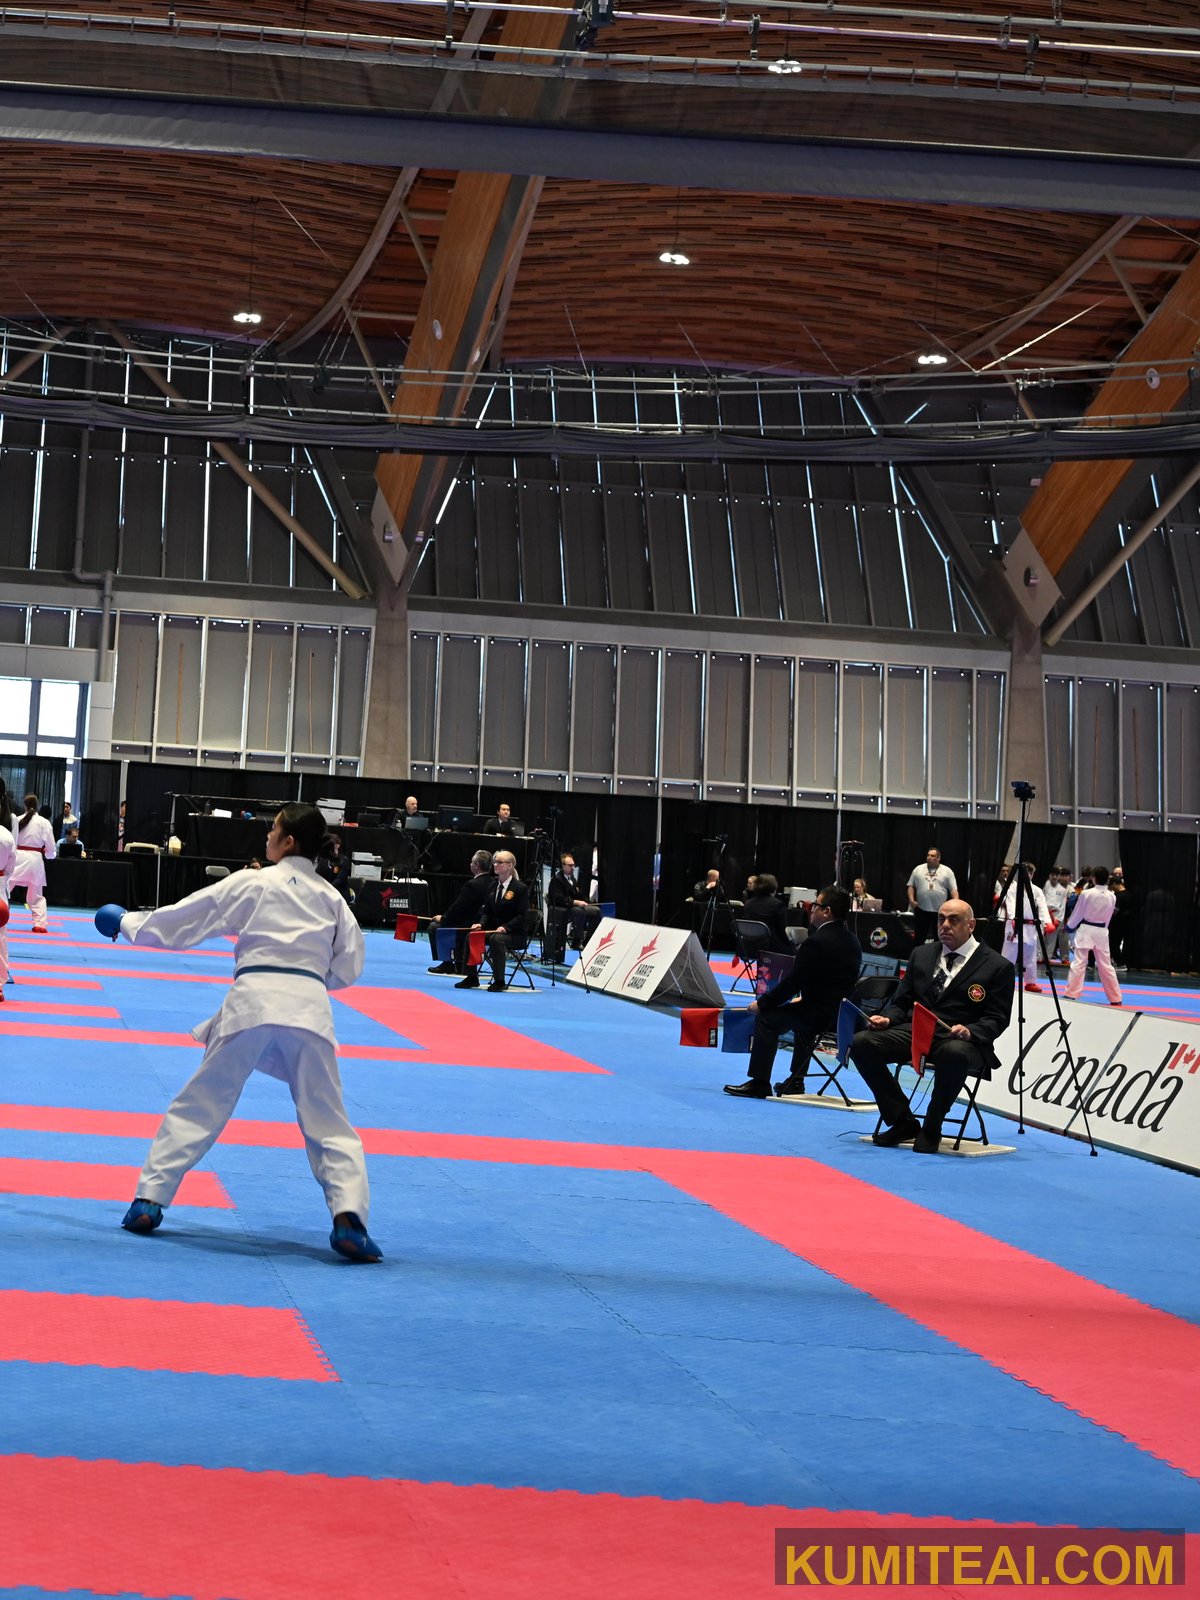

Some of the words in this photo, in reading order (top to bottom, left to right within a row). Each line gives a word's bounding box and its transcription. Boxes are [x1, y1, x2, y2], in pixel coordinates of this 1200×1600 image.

[594, 955, 611, 967] KARATE
[586, 965, 603, 978] CANADA
[635, 964, 654, 977] KARATE
[627, 977, 646, 989] CANADA
[1008, 1018, 1184, 1133] Canada
